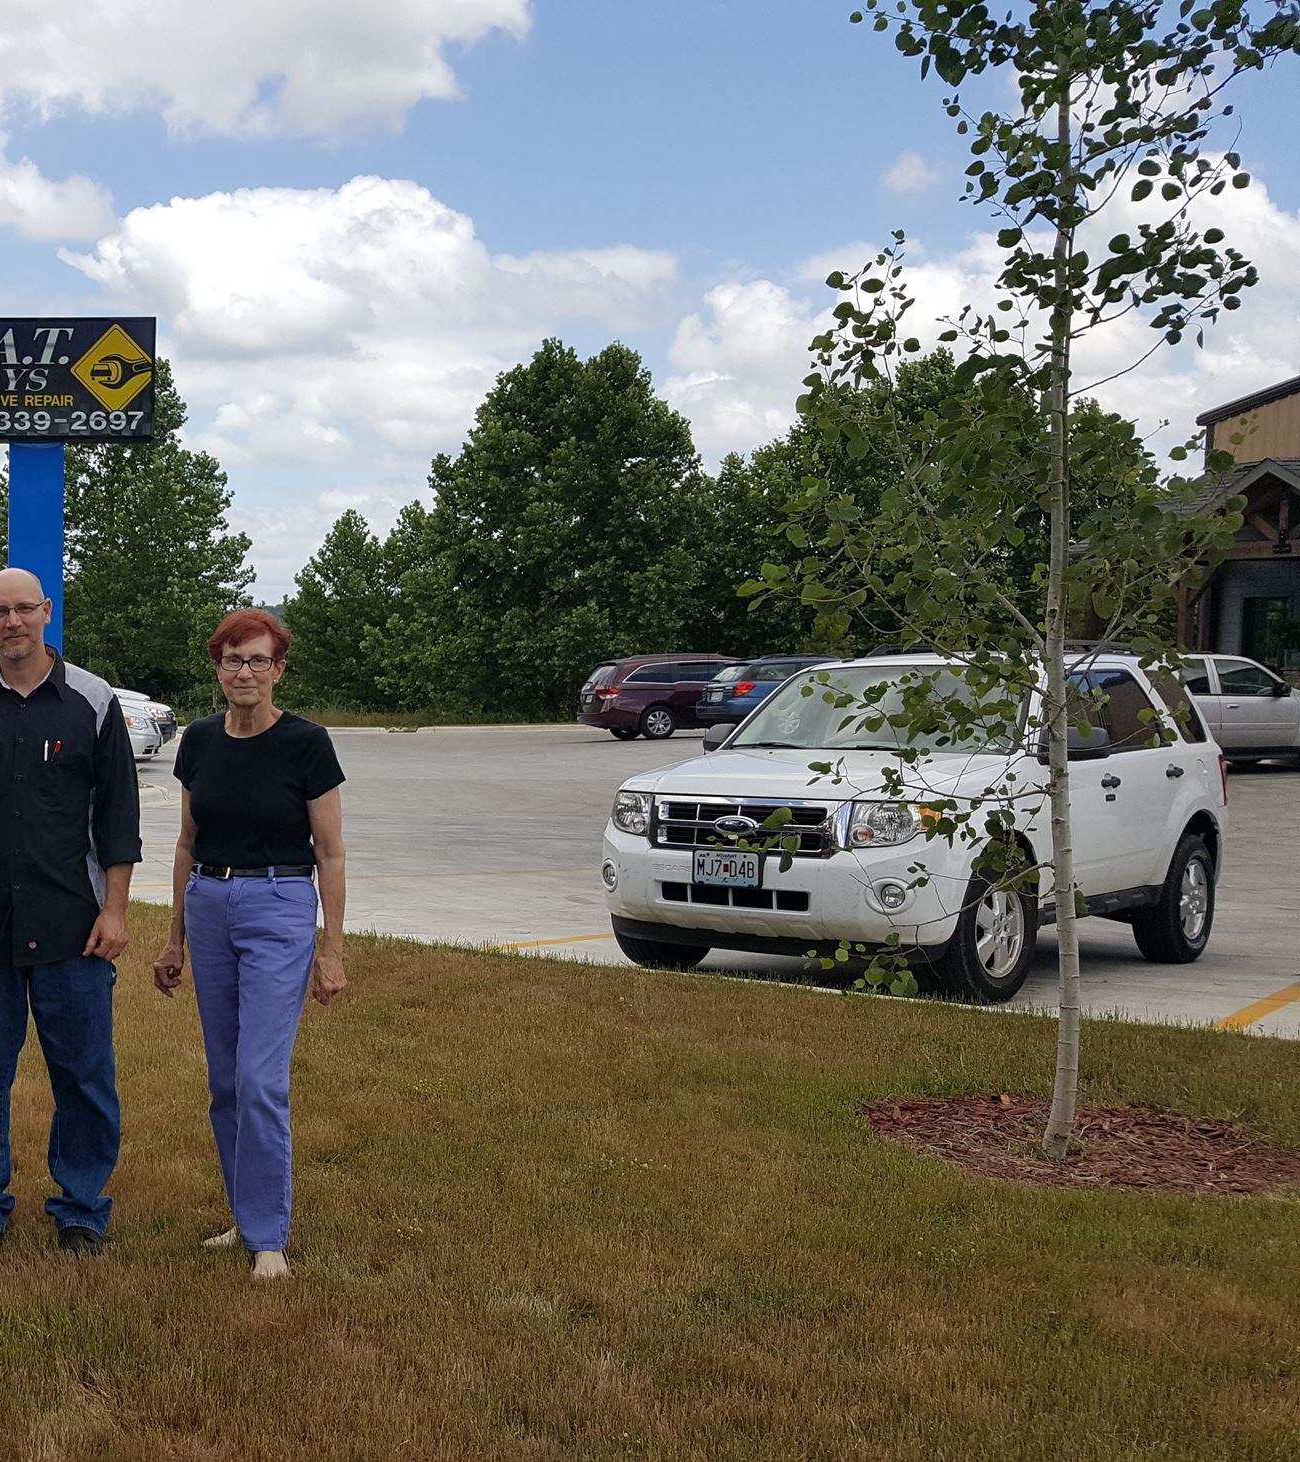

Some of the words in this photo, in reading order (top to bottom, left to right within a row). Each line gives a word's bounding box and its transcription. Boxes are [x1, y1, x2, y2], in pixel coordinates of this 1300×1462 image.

[24, 395, 74, 407] REPAIR
[697, 858, 722, 876] MJ7
[729, 860, 755, 878] D4B
